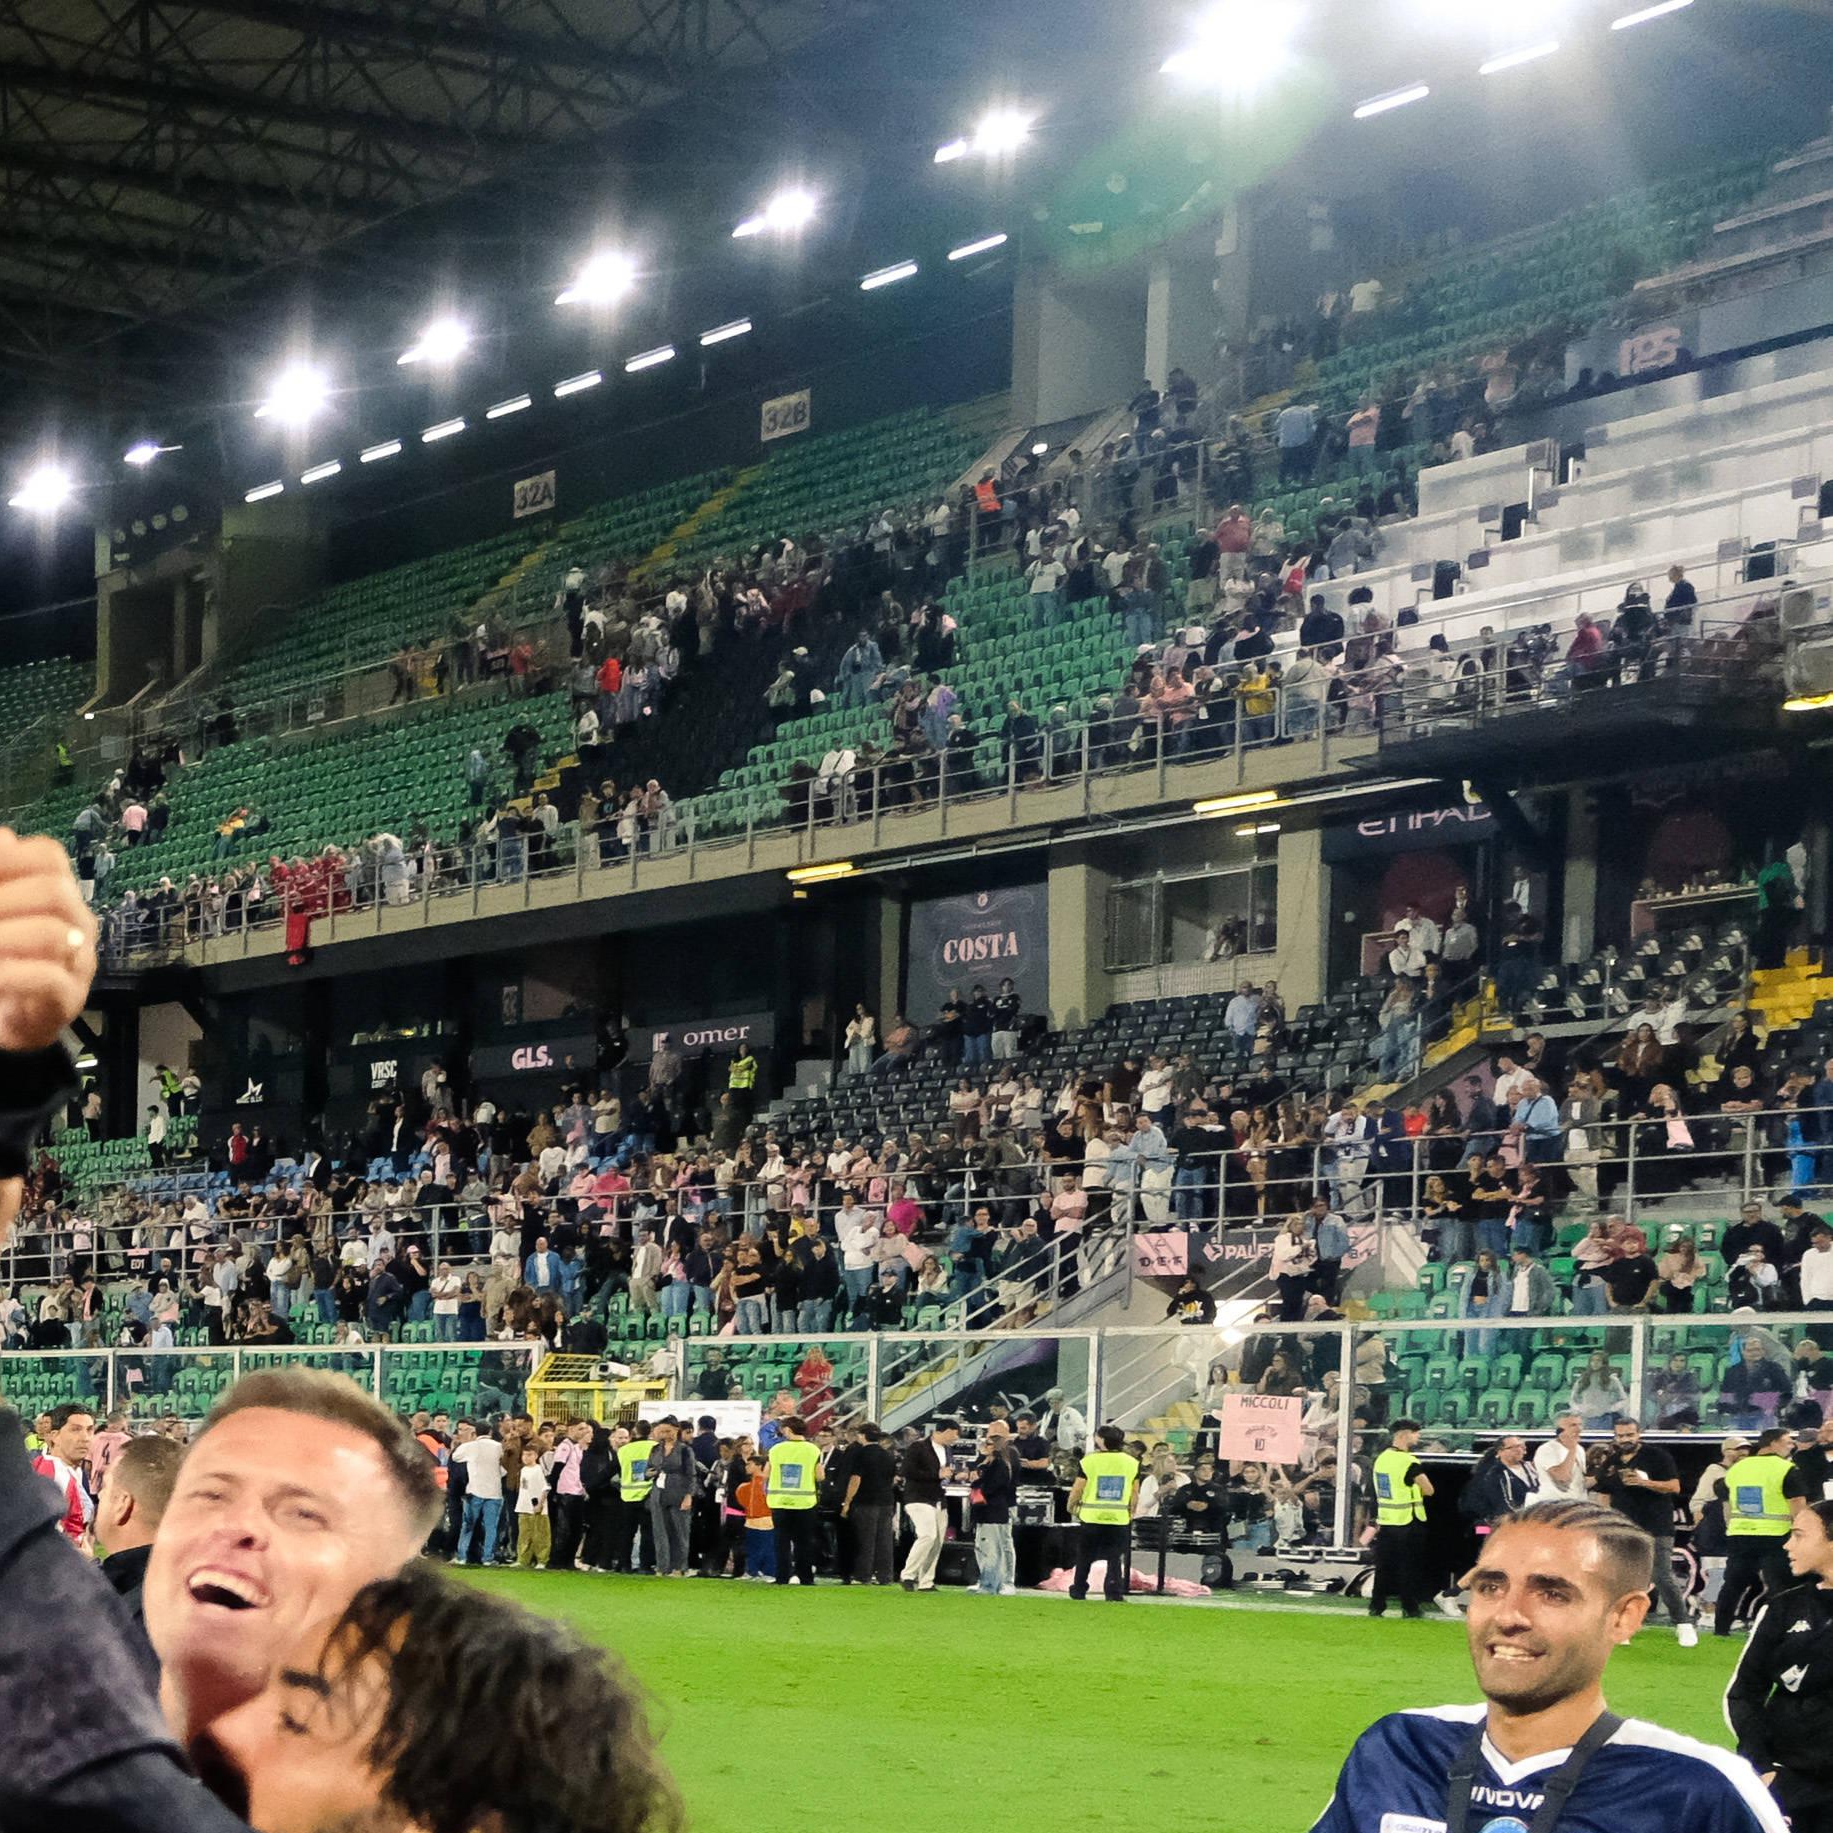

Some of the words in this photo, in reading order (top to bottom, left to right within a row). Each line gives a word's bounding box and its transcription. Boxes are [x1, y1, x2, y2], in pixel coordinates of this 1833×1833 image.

[516, 481, 553, 510] 32A
[944, 931, 1018, 964] COSTA
[683, 1024, 750, 1046] omer
[371, 1060, 397, 1079] VRSC
[1225, 1243, 1275, 1260] PALE
[1240, 1396, 1289, 1410] MICCOLI
[1470, 1785, 1545, 1810] IVOV
